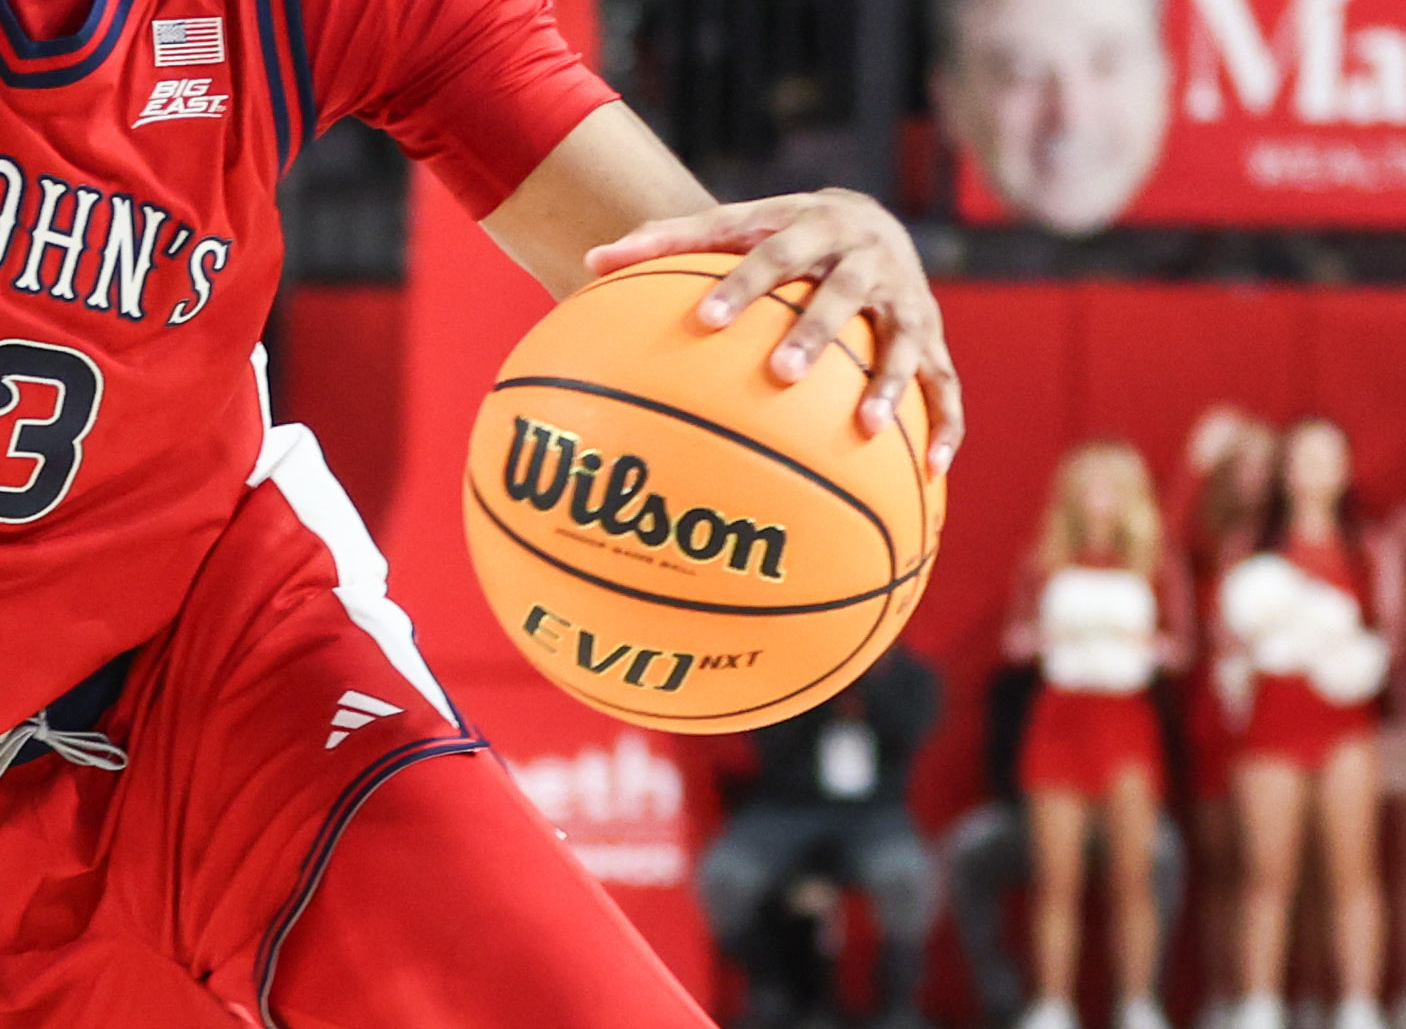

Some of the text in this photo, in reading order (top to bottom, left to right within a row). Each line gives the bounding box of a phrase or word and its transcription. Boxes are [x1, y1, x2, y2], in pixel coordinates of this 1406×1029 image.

[148, 78, 213, 100] BIG
[503, 415, 787, 581] Wilson
[523, 605, 764, 692] EVO NXT
[502, 733, 684, 823] eth
